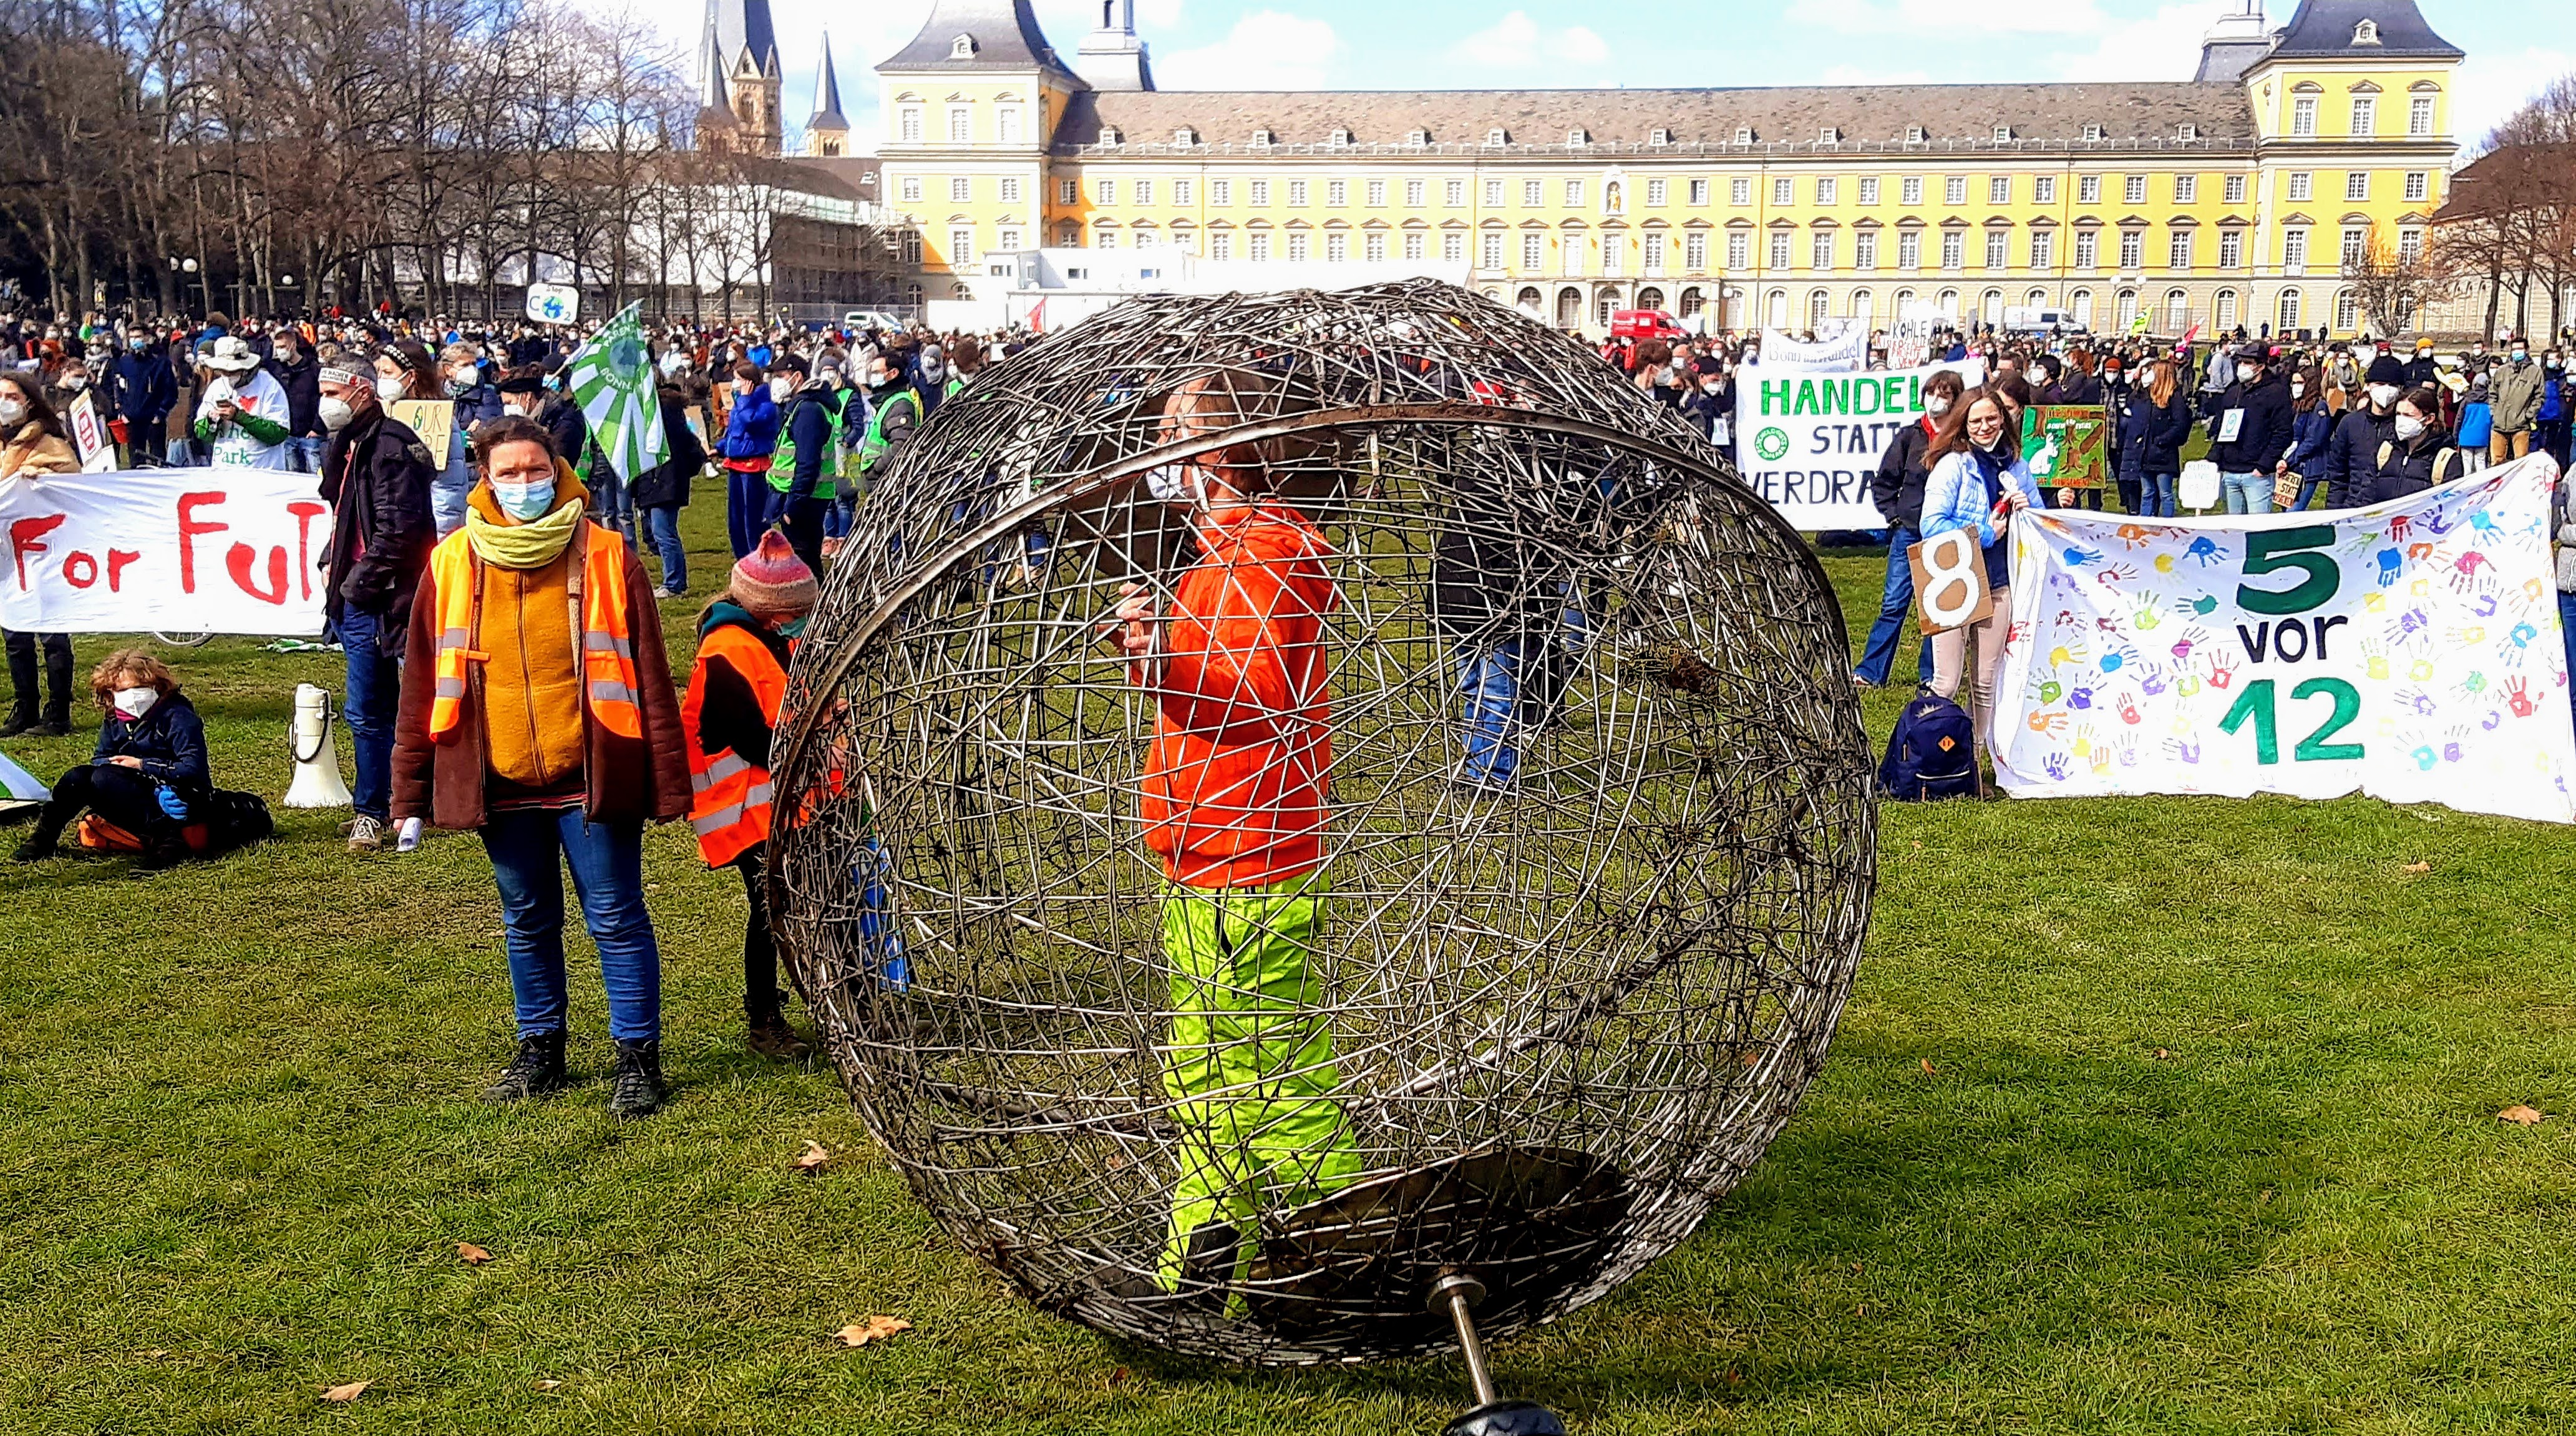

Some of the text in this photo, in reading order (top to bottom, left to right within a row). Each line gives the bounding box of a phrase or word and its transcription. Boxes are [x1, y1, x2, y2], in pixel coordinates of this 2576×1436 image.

[1893, 319, 1927, 339] KOHLE
[600, 367, 631, 390] BONN
[1761, 375, 1927, 415] HANDEL
[414, 405, 442, 433] OUR
[1810, 421, 1901, 454] STATT
[213, 447, 252, 465] Park
[10, 513, 140, 593] For
[2236, 525, 2340, 616] 5
[1921, 528, 1980, 628] 8
[2237, 614, 2348, 663] vor
[2217, 676, 2365, 766] 12
